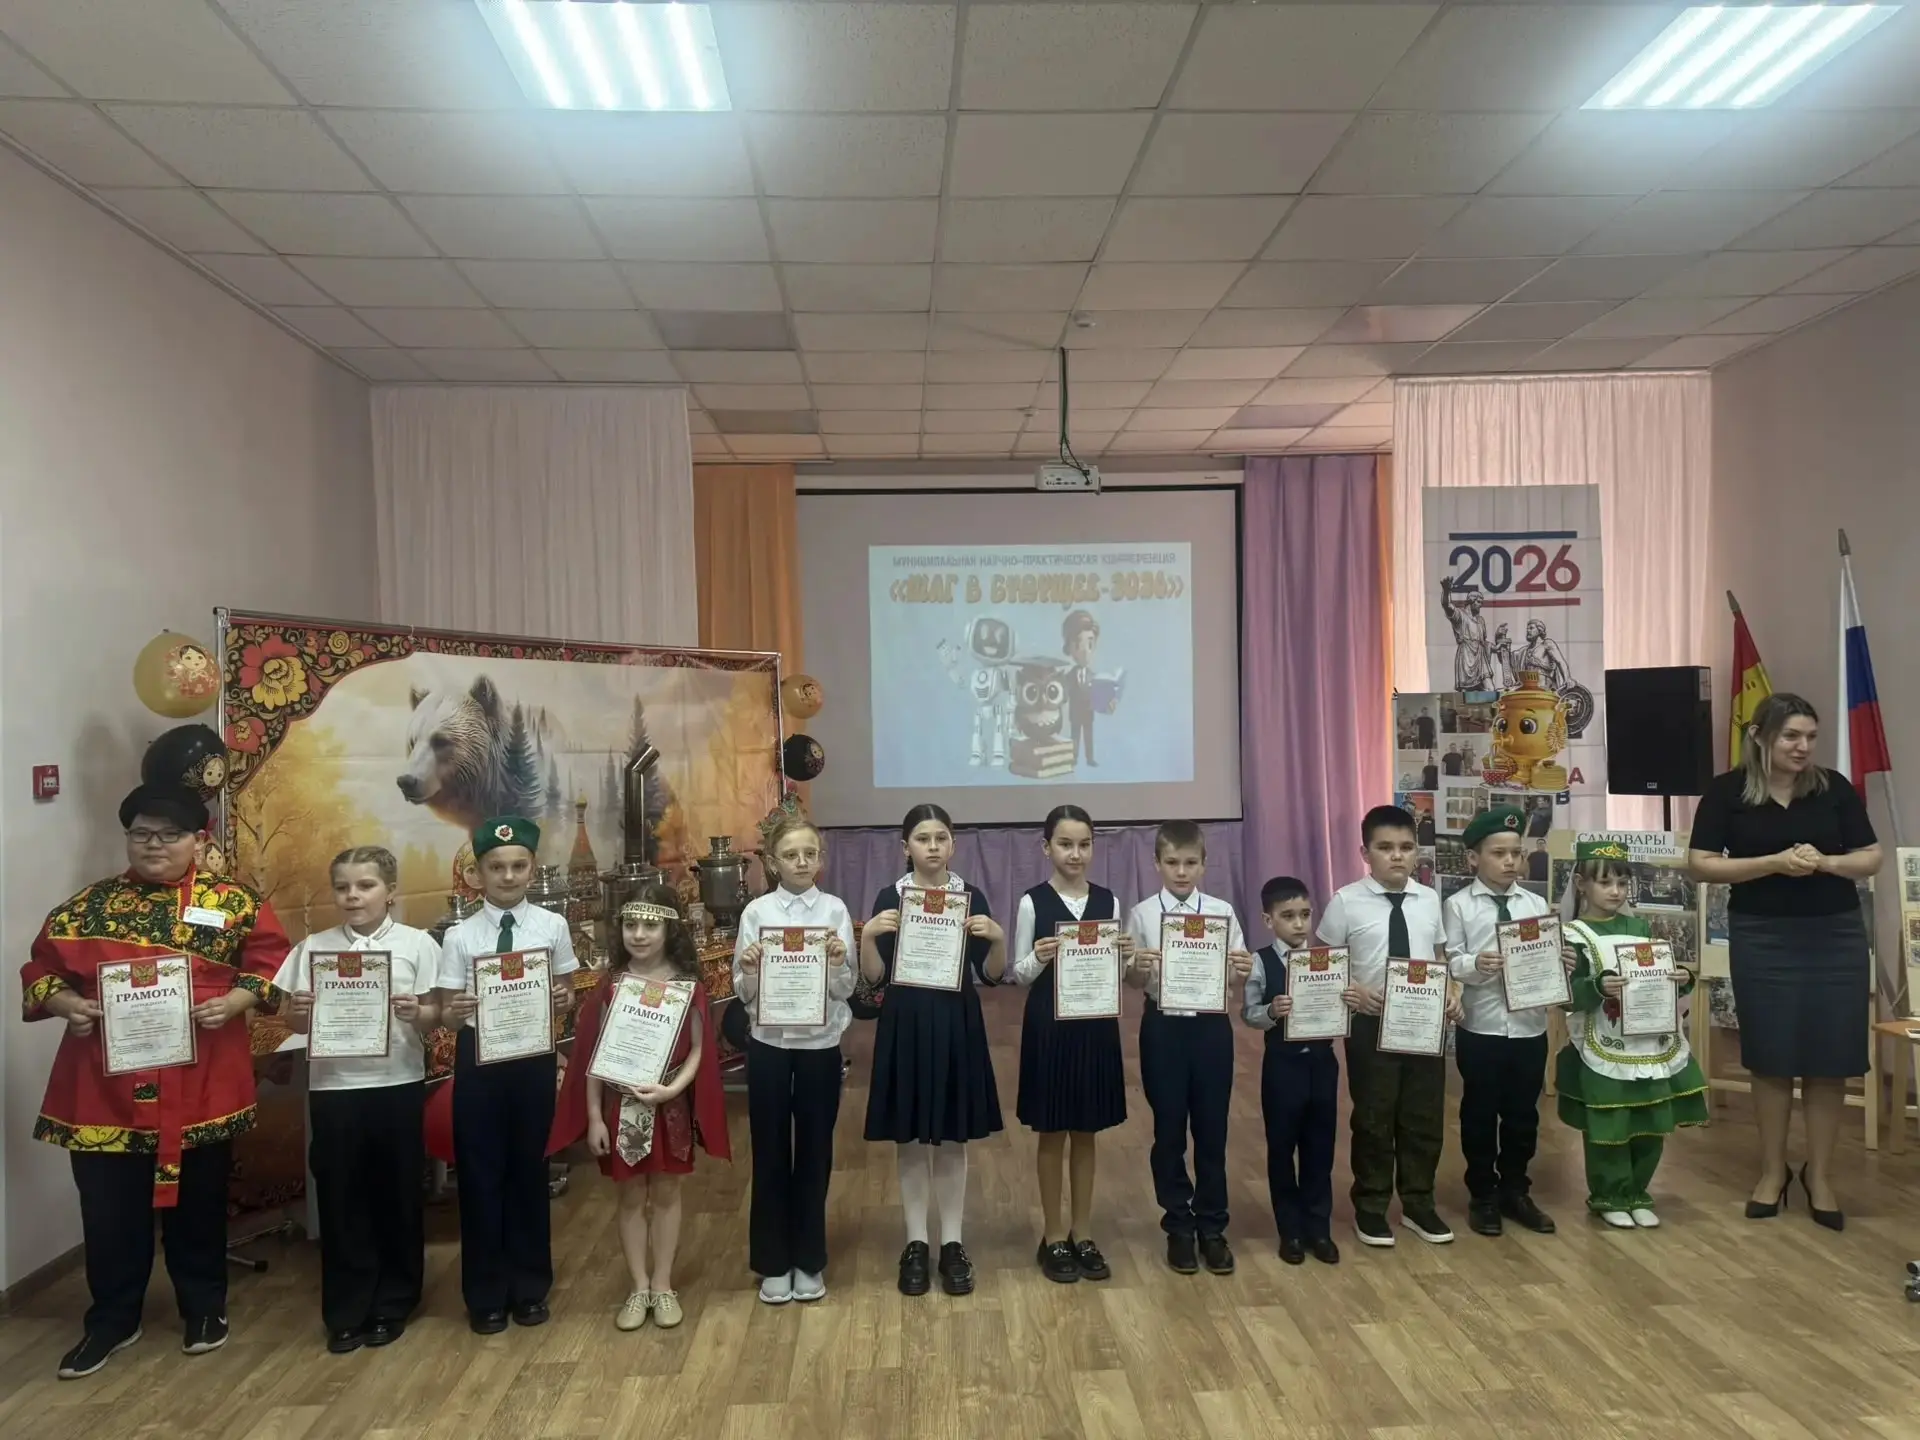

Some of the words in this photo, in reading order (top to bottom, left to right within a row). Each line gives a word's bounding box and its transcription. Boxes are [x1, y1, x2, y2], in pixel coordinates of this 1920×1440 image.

[1449, 544, 1580, 593] 2026
[965, 574, 982, 603] В
[1568, 767, 1585, 784] А
[1577, 833, 1666, 846] САМОВАРЫ
[910, 915, 956, 927] ГРАМОТА
[1172, 940, 1218, 950] ГРАМОТА
[1511, 940, 1554, 954] ГРАМОТА
[1067, 947, 1111, 956] ГРАМОТА
[771, 955, 818, 963] ГРАМОТА
[1298, 973, 1342, 982] ГРАМОТА
[1629, 969, 1668, 978] ГРАМОТА
[325, 981, 379, 989] ГРАМОТА
[488, 980, 540, 995] ГРАМОТА
[1396, 985, 1438, 996] ГРАМОТА
[116, 987, 177, 1003] ГРАМОТА
[622, 1004, 671, 1024] ГРАМОТА
